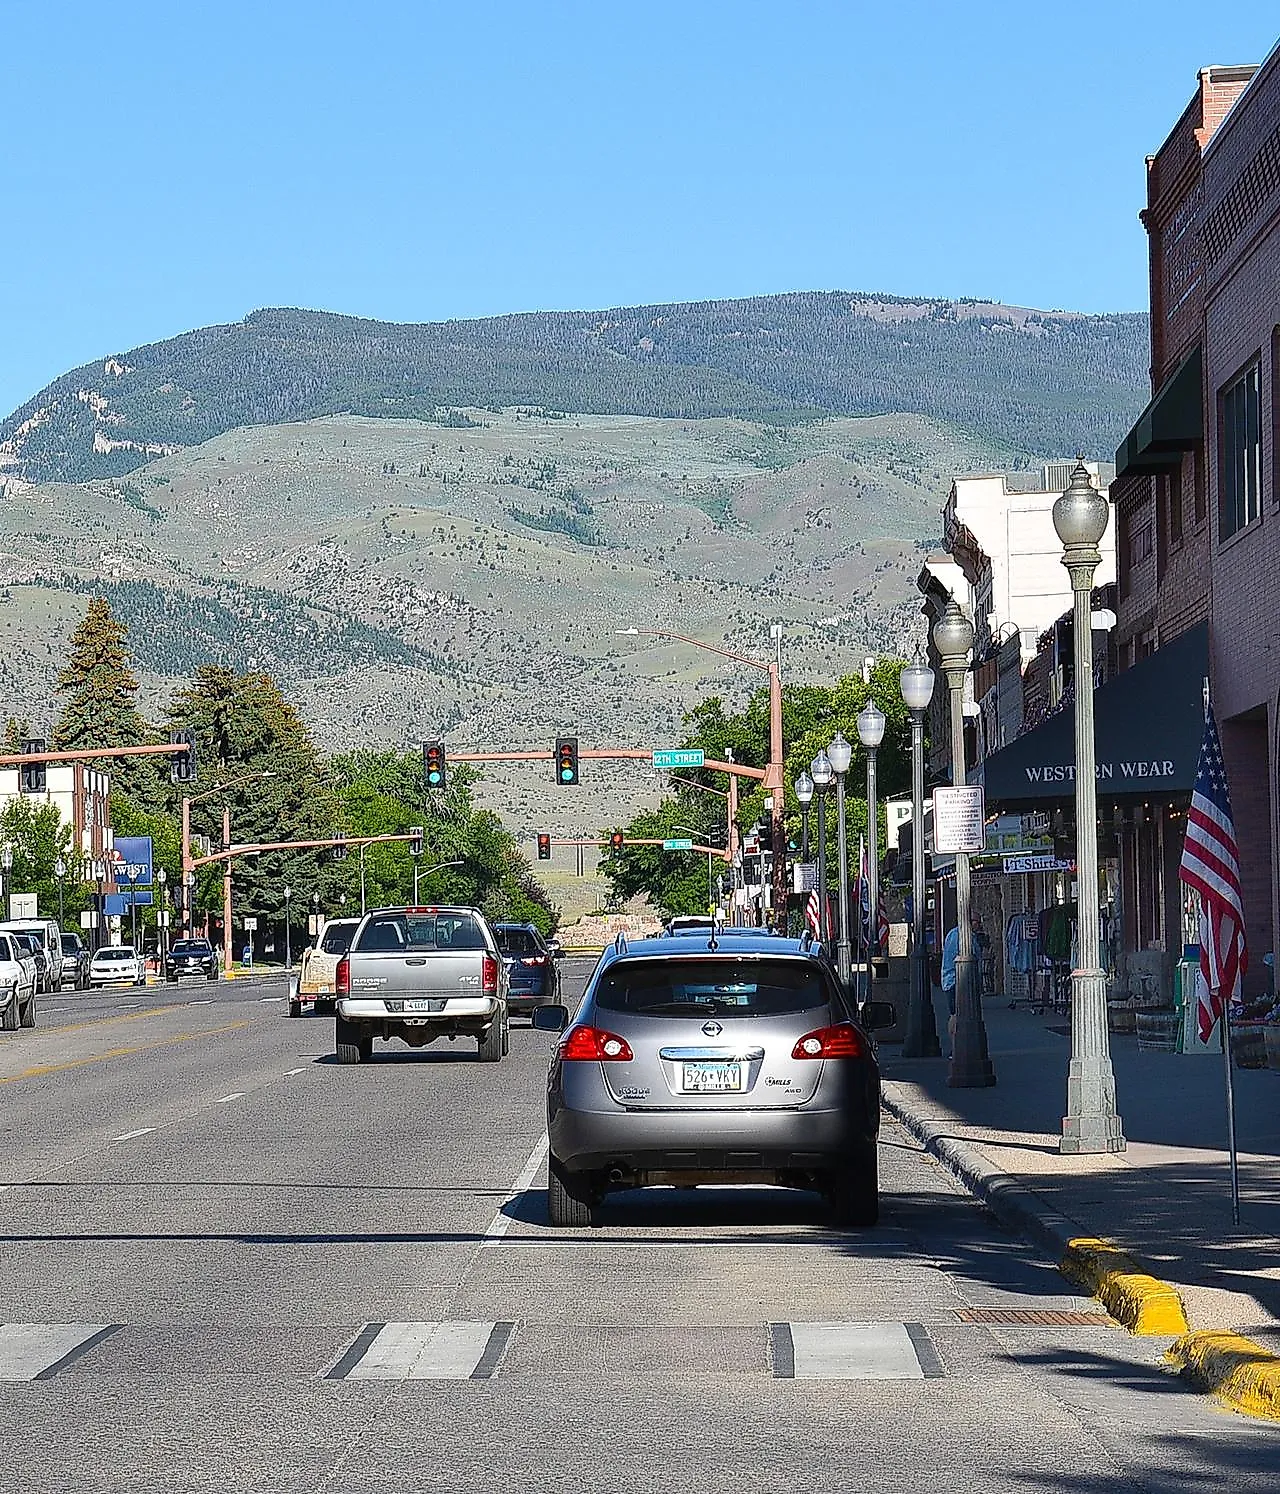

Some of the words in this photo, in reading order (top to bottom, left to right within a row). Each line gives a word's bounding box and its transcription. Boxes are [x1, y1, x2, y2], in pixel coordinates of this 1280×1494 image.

[674, 752, 702, 764] STREET
[1120, 760, 1175, 777] WEAR
[686, 1069, 708, 1083] 526
[716, 1069, 738, 1083] VKY
